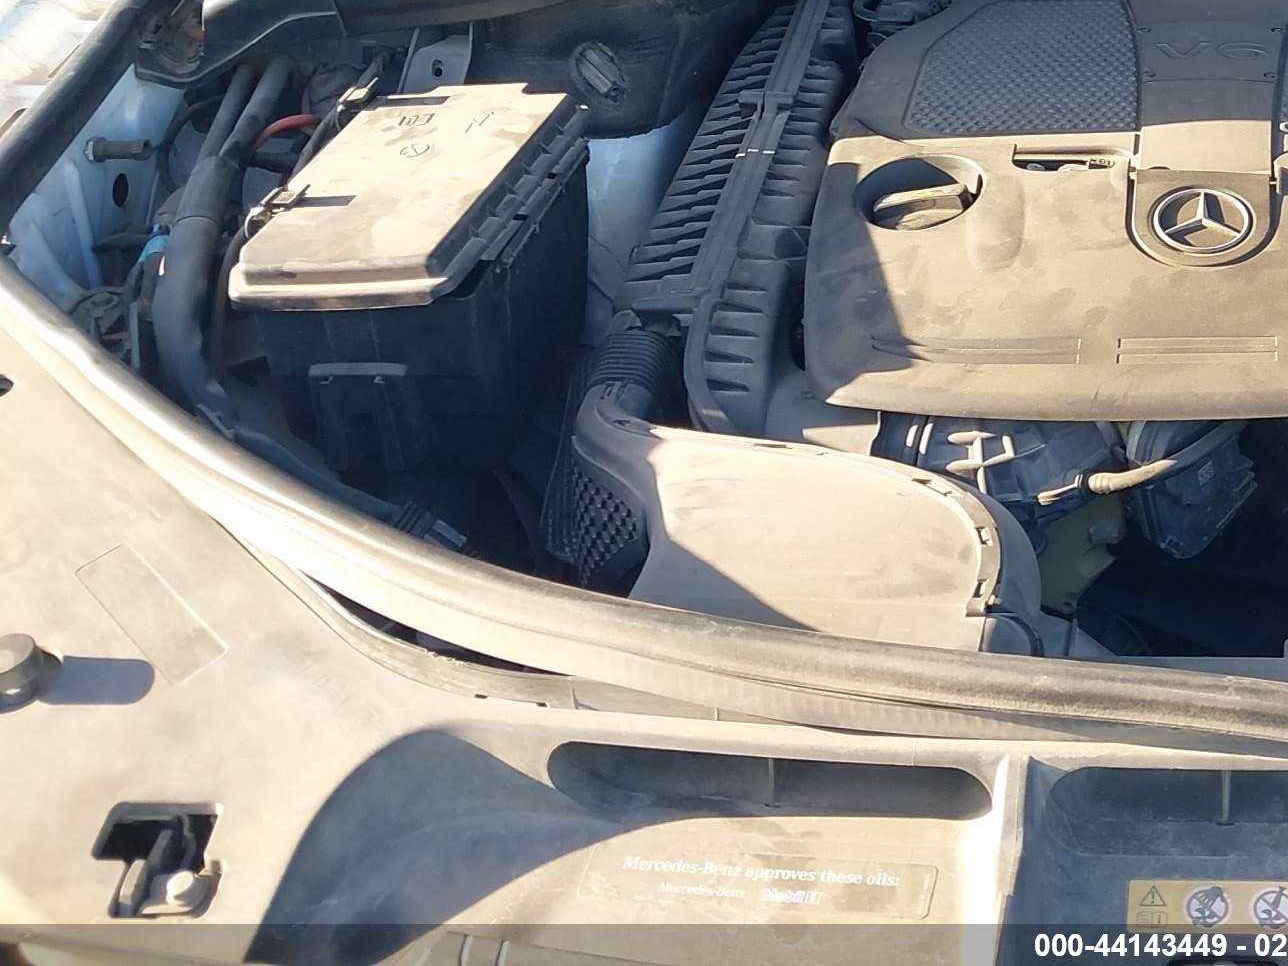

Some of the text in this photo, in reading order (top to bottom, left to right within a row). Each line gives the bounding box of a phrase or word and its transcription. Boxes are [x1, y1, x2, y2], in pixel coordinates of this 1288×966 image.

[1156, 40, 1268, 58] V6
[623, 856, 900, 888] Mercedes-Benz approves these oils:
